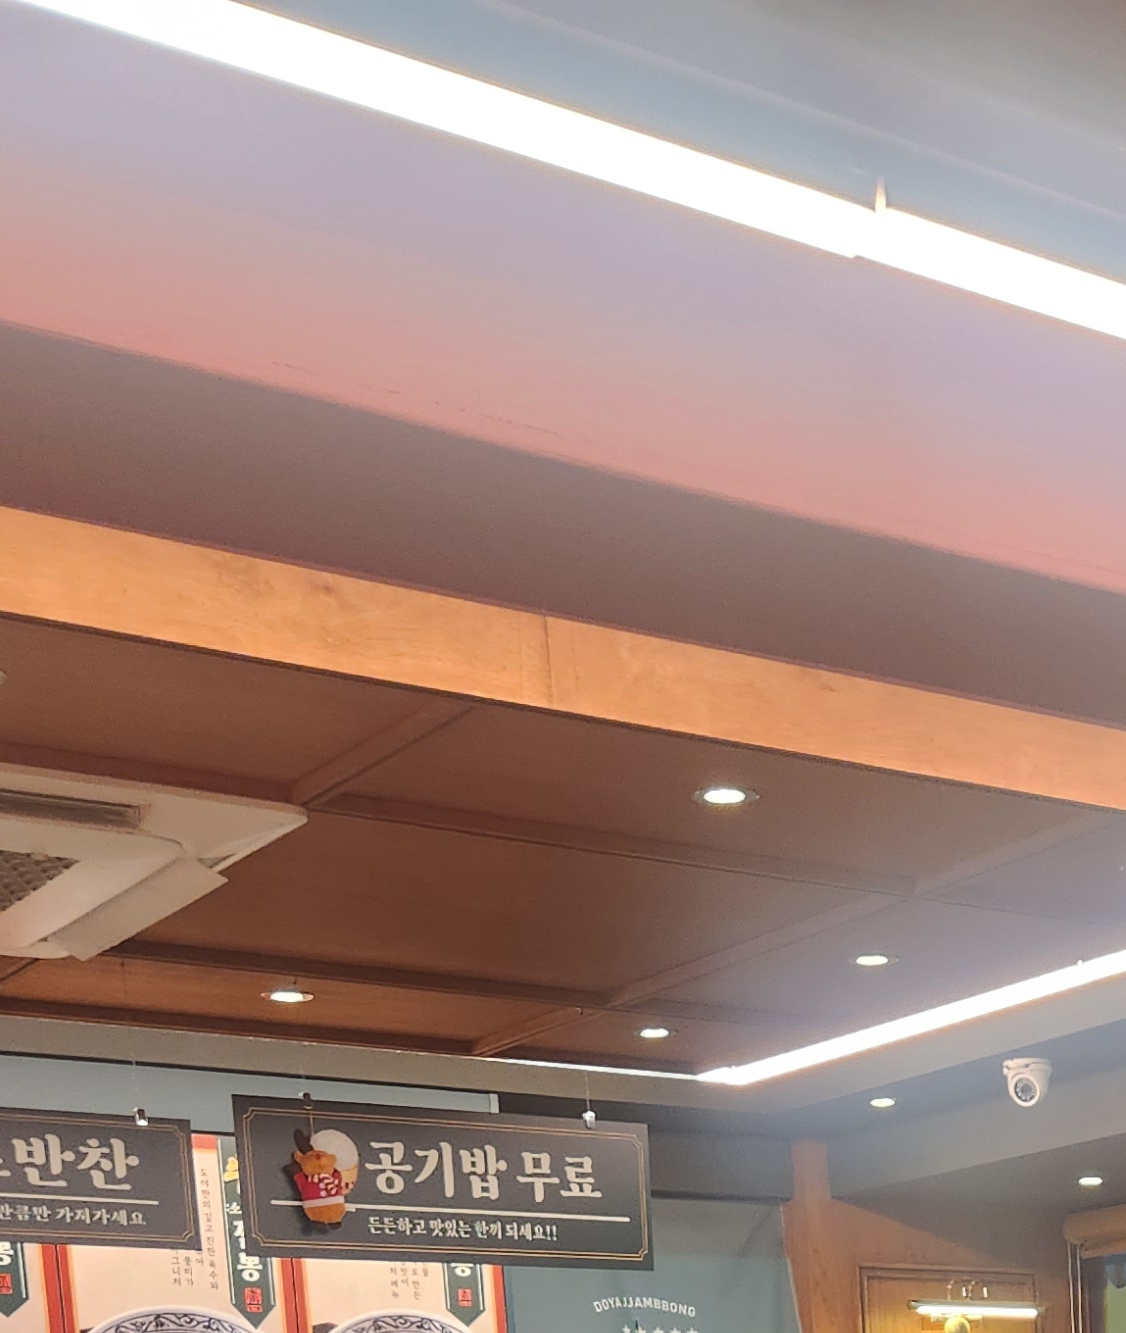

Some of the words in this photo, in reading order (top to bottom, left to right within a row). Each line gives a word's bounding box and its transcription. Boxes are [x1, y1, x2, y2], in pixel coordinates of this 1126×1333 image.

[0, 1133, 140, 1191] 반찬
[365, 1141, 505, 1203] 공기밥
[515, 1148, 603, 1203] 무료
[367, 1217, 428, 1238] 든든하고
[429, 1219, 472, 1240] 맛있는
[474, 1221, 504, 1240] 한끼
[505, 1222, 559, 1243] 되세요!!
[593, 1296, 697, 1318] DOYAJJAMBBONG
